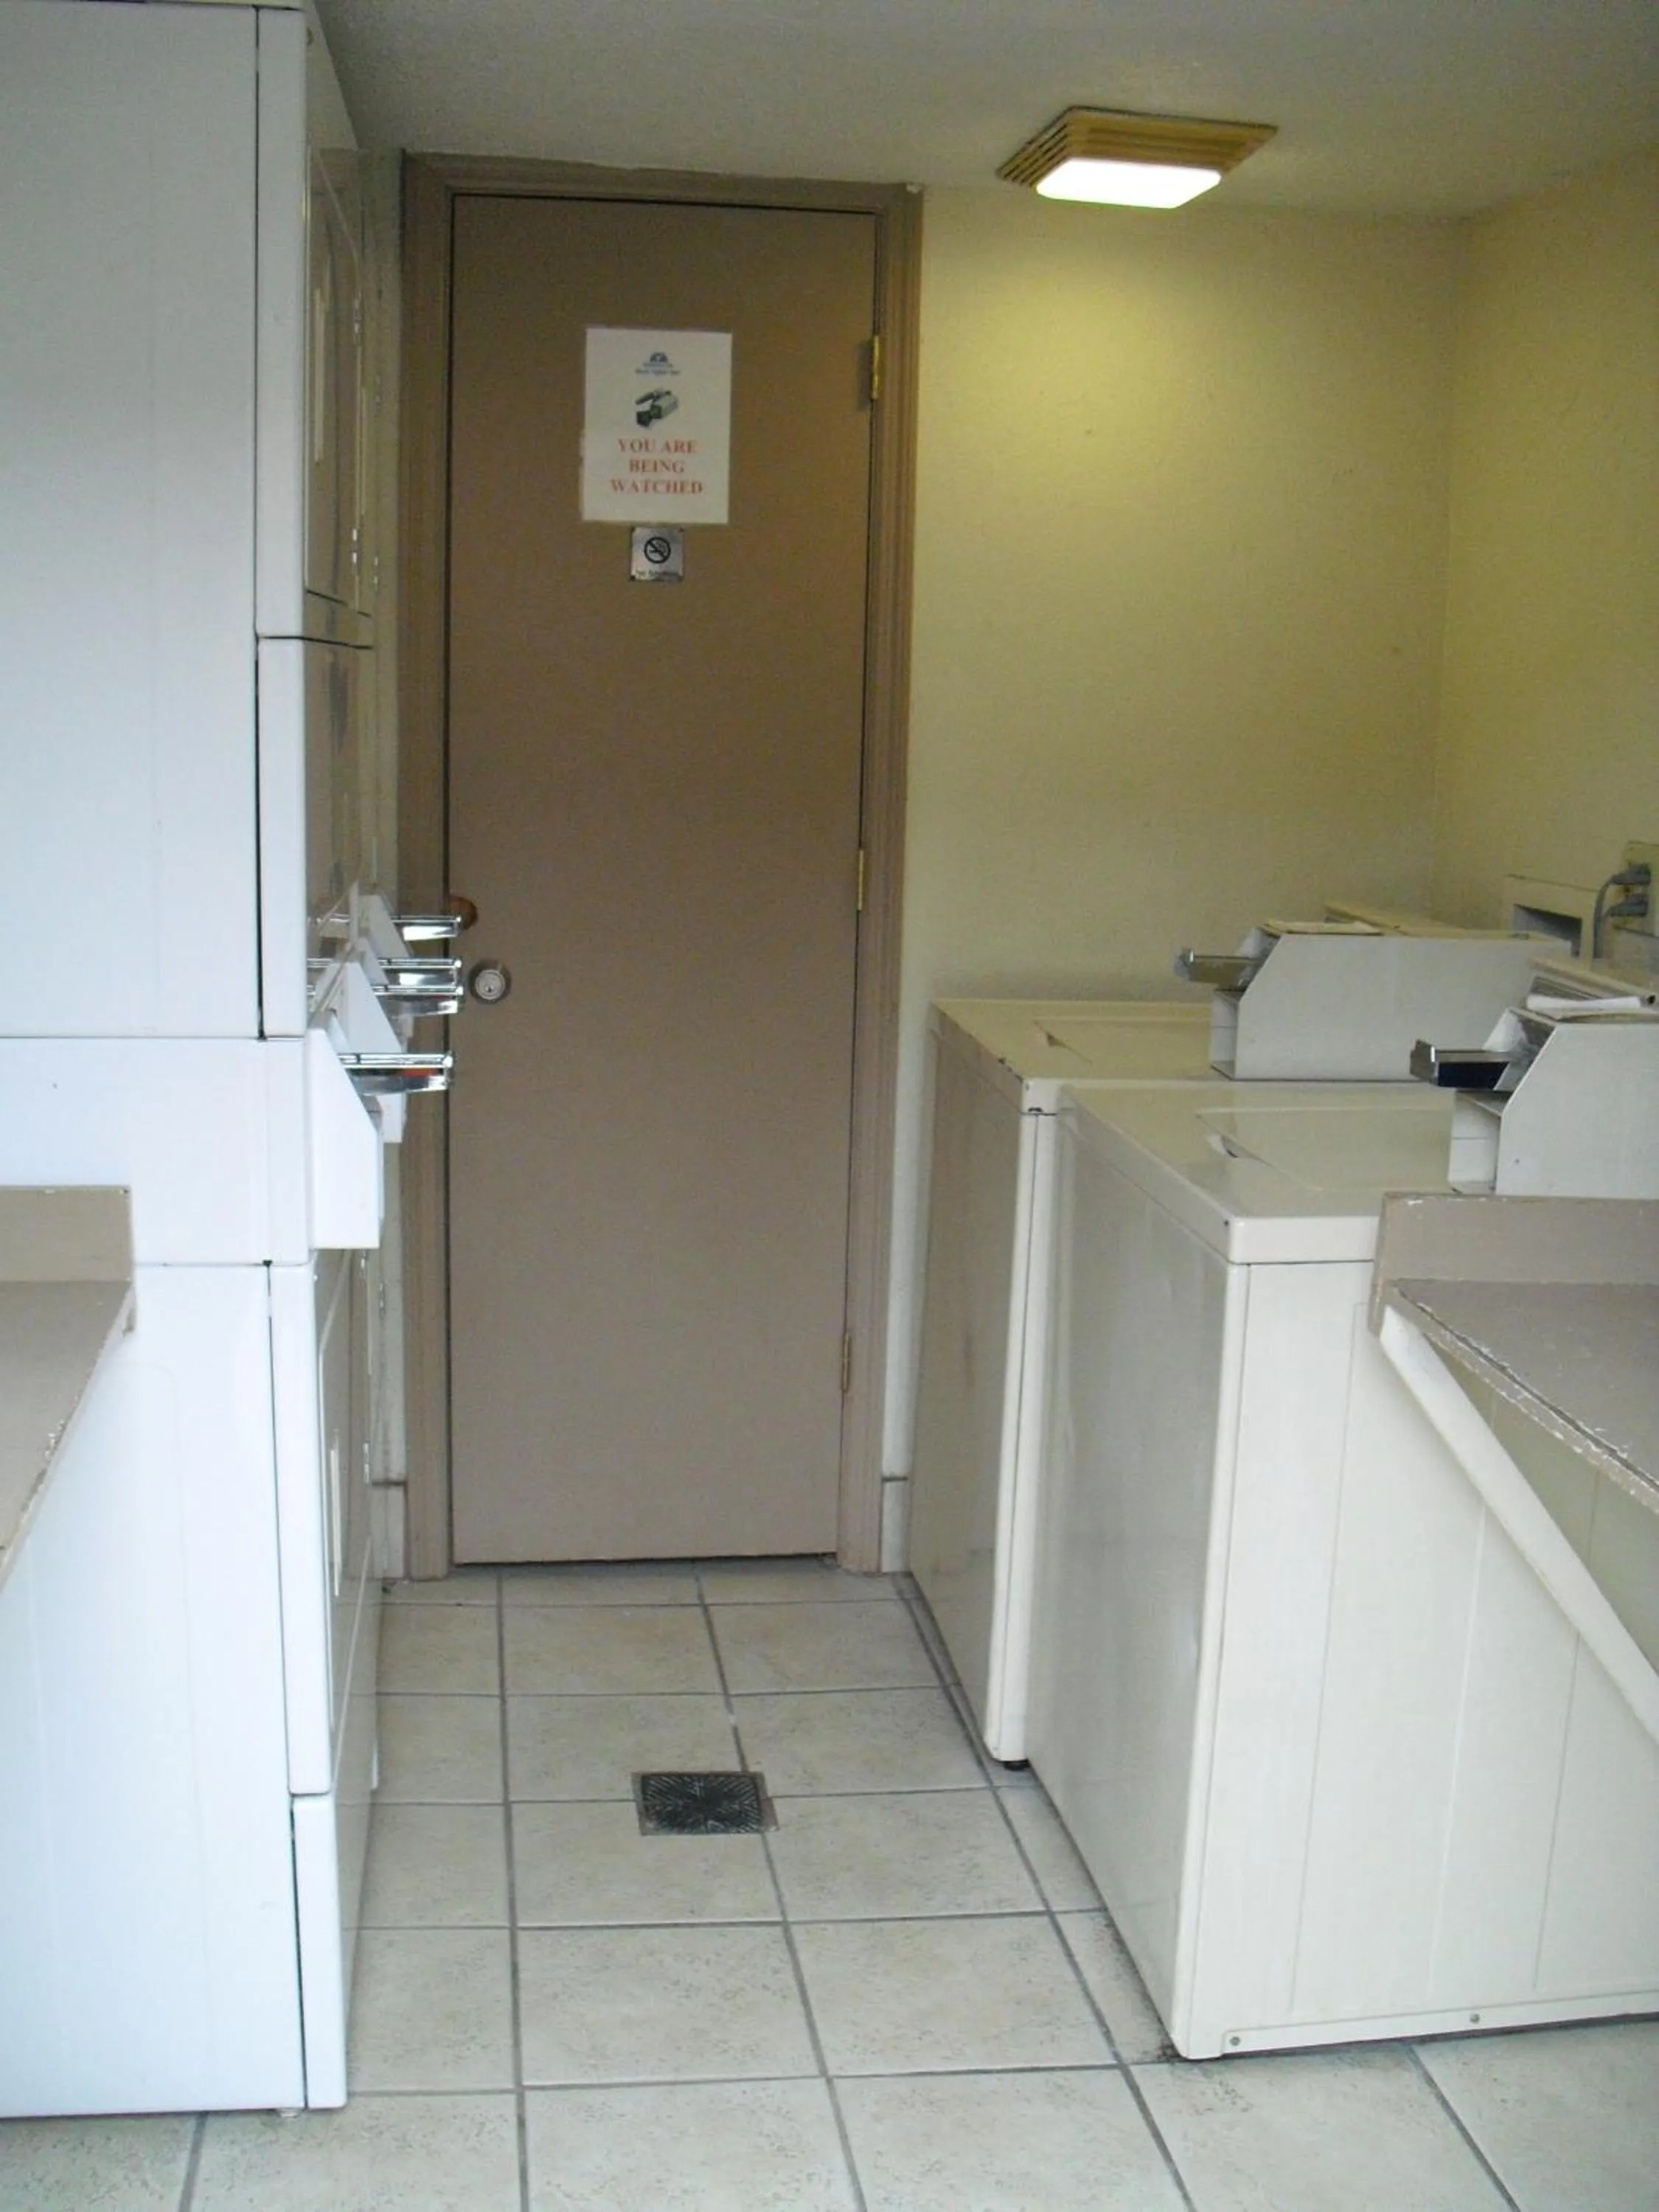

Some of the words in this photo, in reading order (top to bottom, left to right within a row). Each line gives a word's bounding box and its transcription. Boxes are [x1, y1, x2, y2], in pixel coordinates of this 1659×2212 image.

[617, 438, 656, 453] YOU
[661, 439, 698, 454] ARE
[629, 458, 685, 473] BEING
[611, 479, 703, 495] WATCHED
